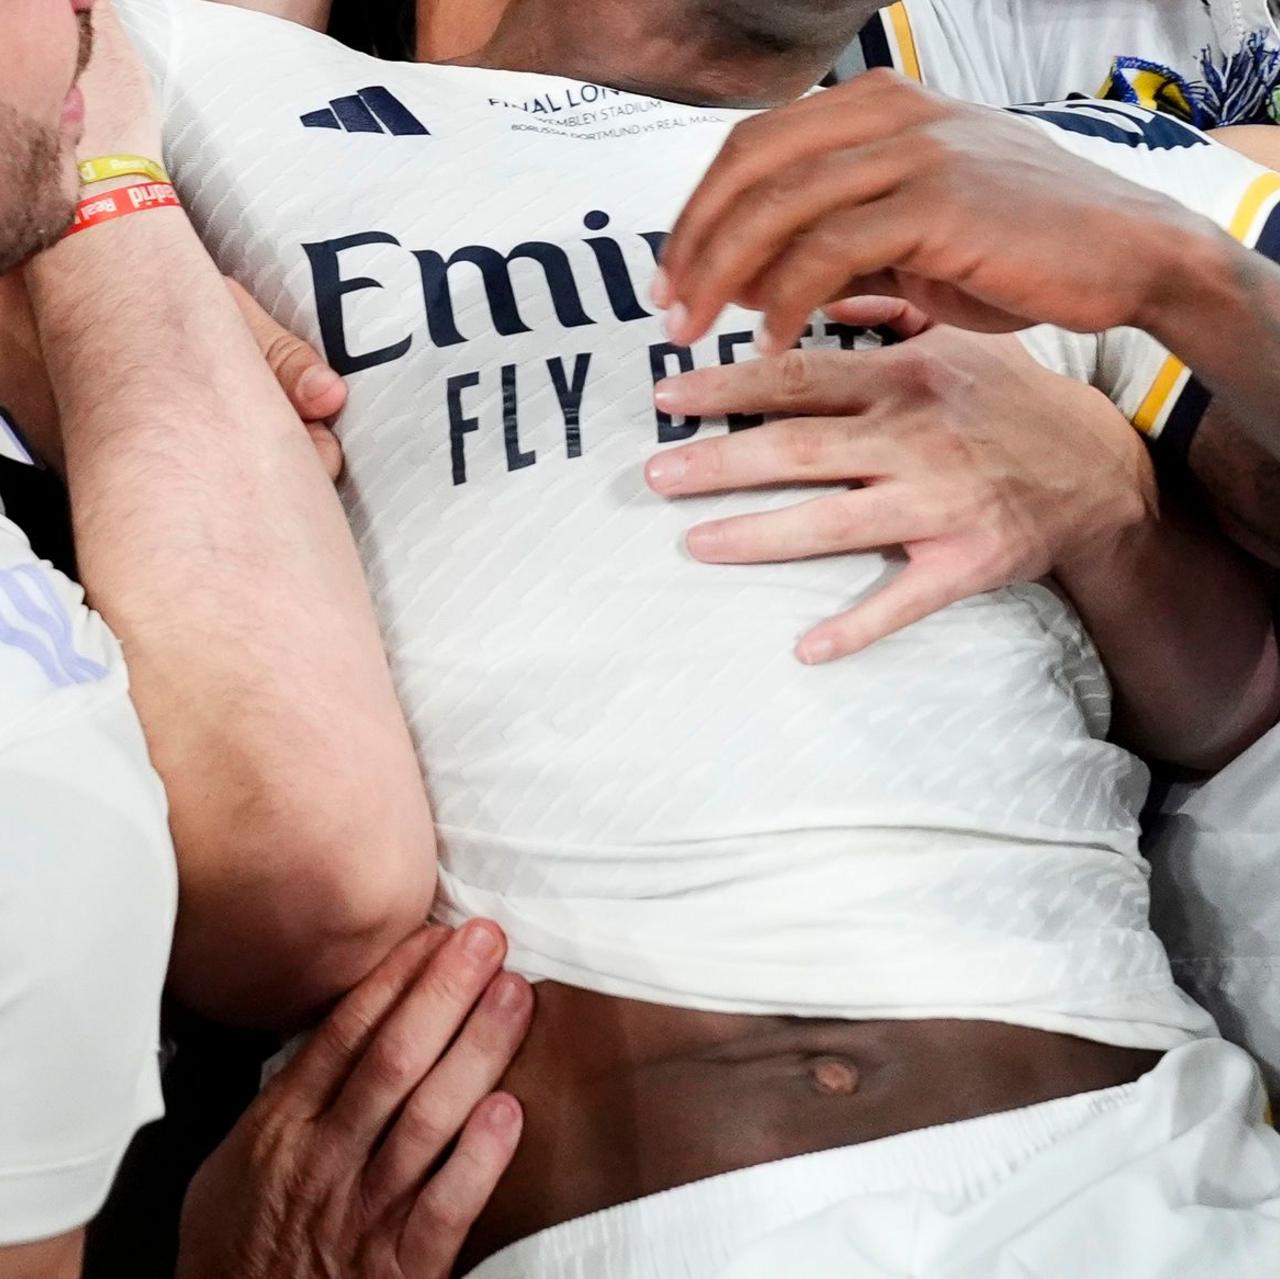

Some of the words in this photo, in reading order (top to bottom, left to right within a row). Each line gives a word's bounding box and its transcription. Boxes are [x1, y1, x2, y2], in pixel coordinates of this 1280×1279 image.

[600, 100, 663, 121] STADIUM
[656, 118, 687, 130] REAL
[446, 352, 593, 486] FLY
